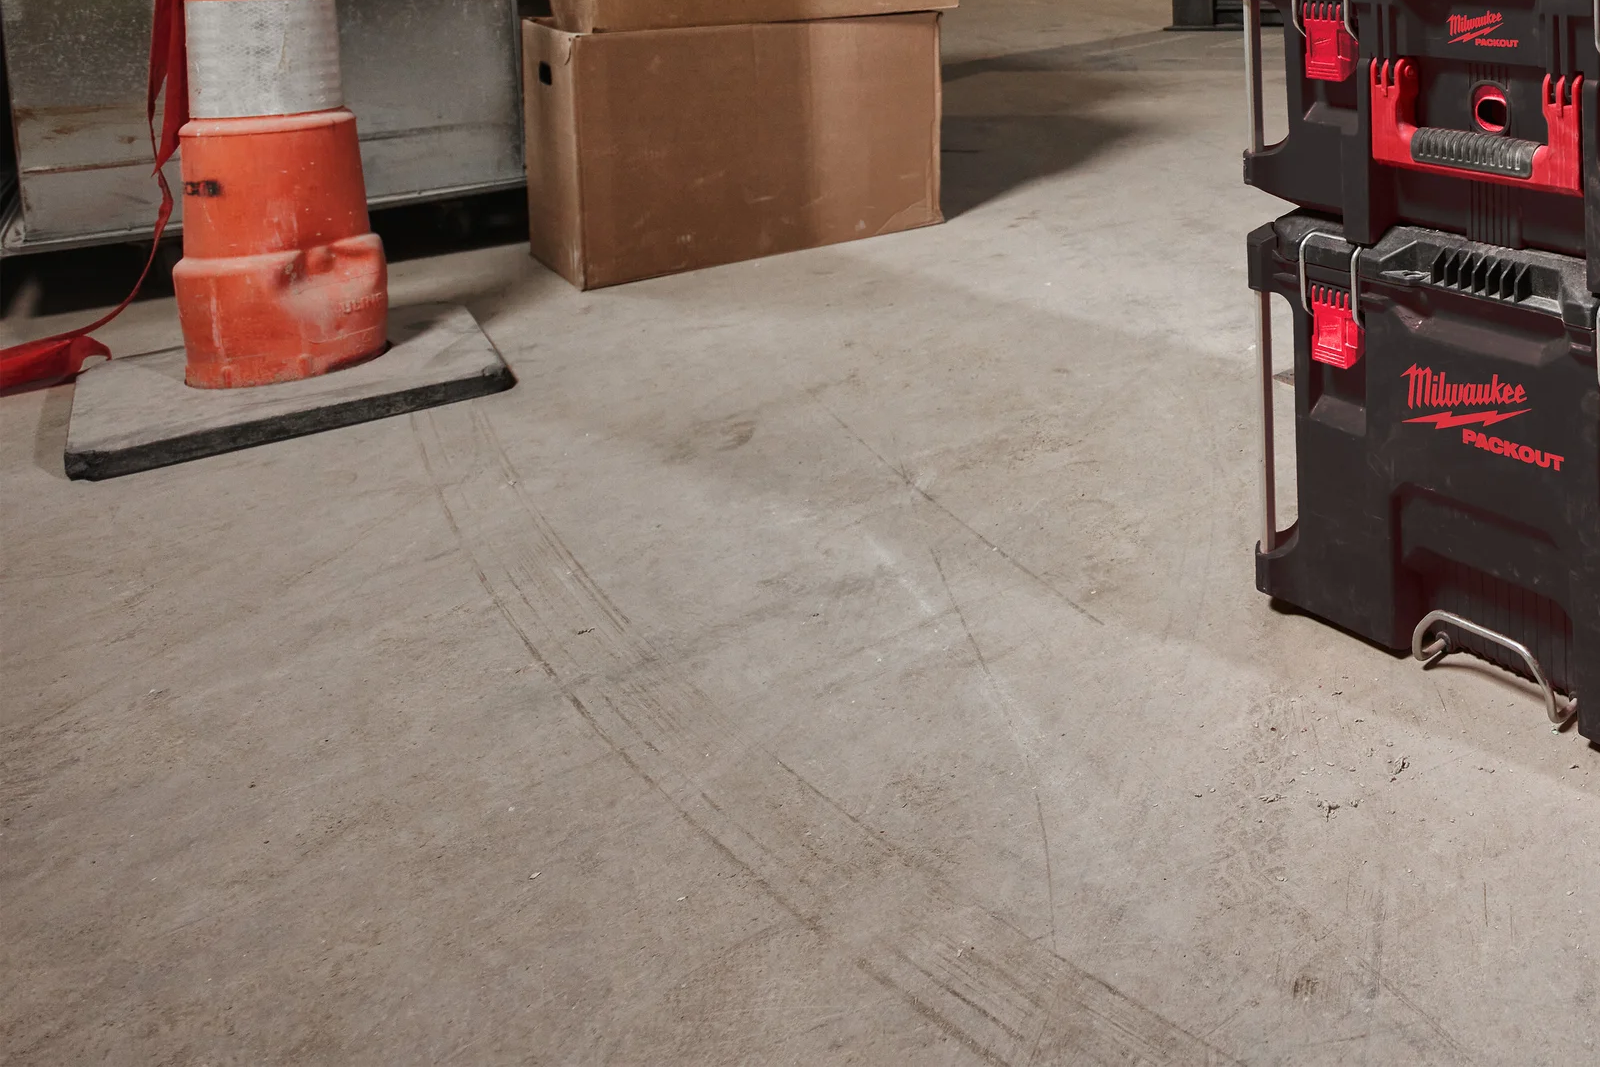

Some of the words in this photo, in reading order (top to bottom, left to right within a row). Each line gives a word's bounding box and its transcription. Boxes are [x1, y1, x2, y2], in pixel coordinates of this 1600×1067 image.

[1445, 10, 1503, 36] Milwaukee
[1475, 38, 1519, 48] PACKOUT
[1400, 363, 1528, 410] Milwaukee
[1462, 428, 1565, 472] PACKOUT
